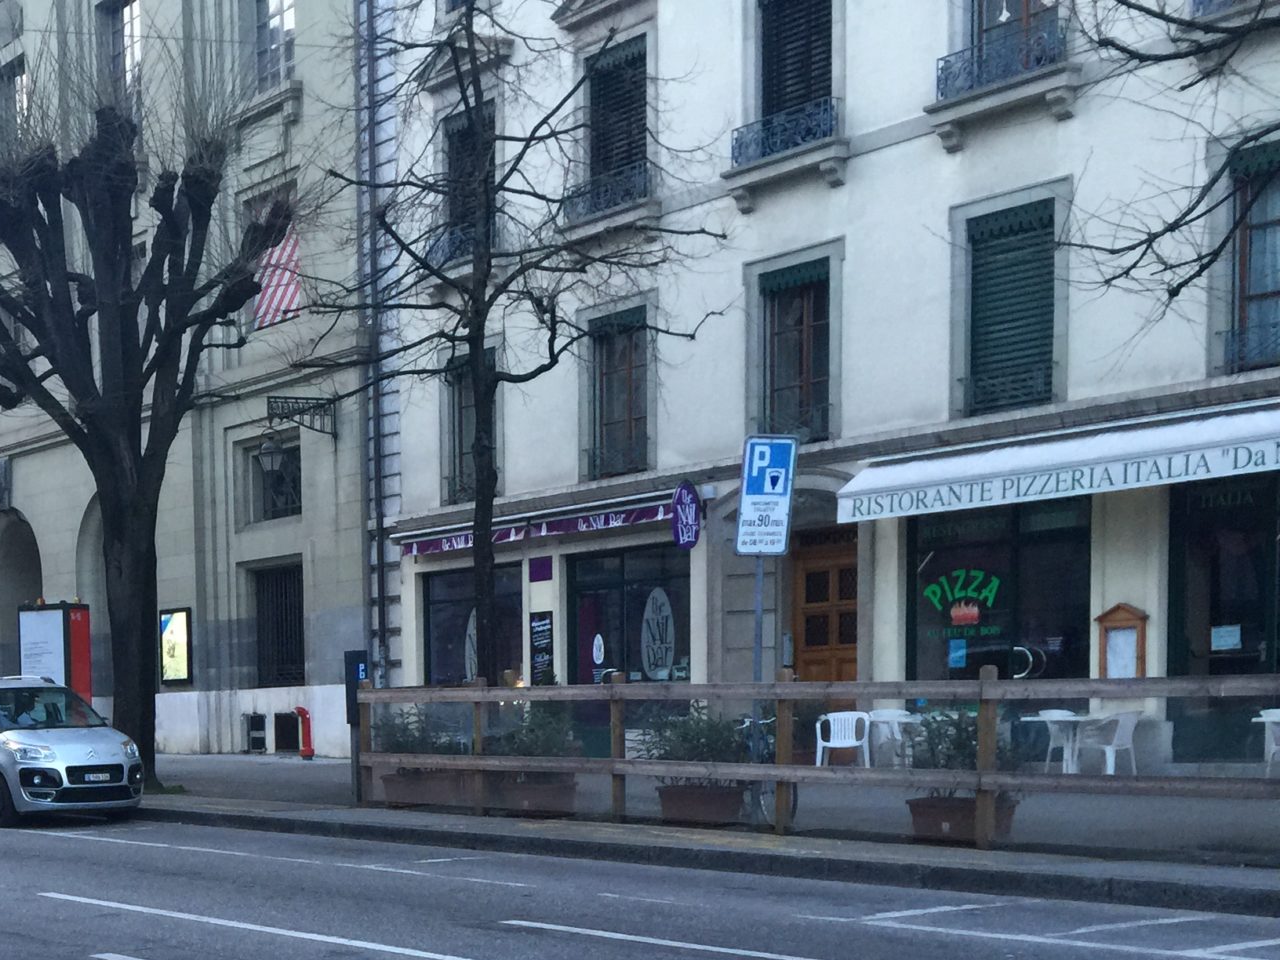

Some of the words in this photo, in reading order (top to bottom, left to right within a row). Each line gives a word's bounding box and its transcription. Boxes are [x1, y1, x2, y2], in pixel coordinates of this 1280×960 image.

[752, 445, 771, 477] P
[850, 480, 993, 518] RISTORANTE
[1001, 466, 1115, 500] PIZZERIA
[1122, 452, 1212, 485] ITALIA
[1222, 445, 1266, 470] "Da
[757, 514, 771, 528] 90
[923, 568, 1001, 611] PIZZA
